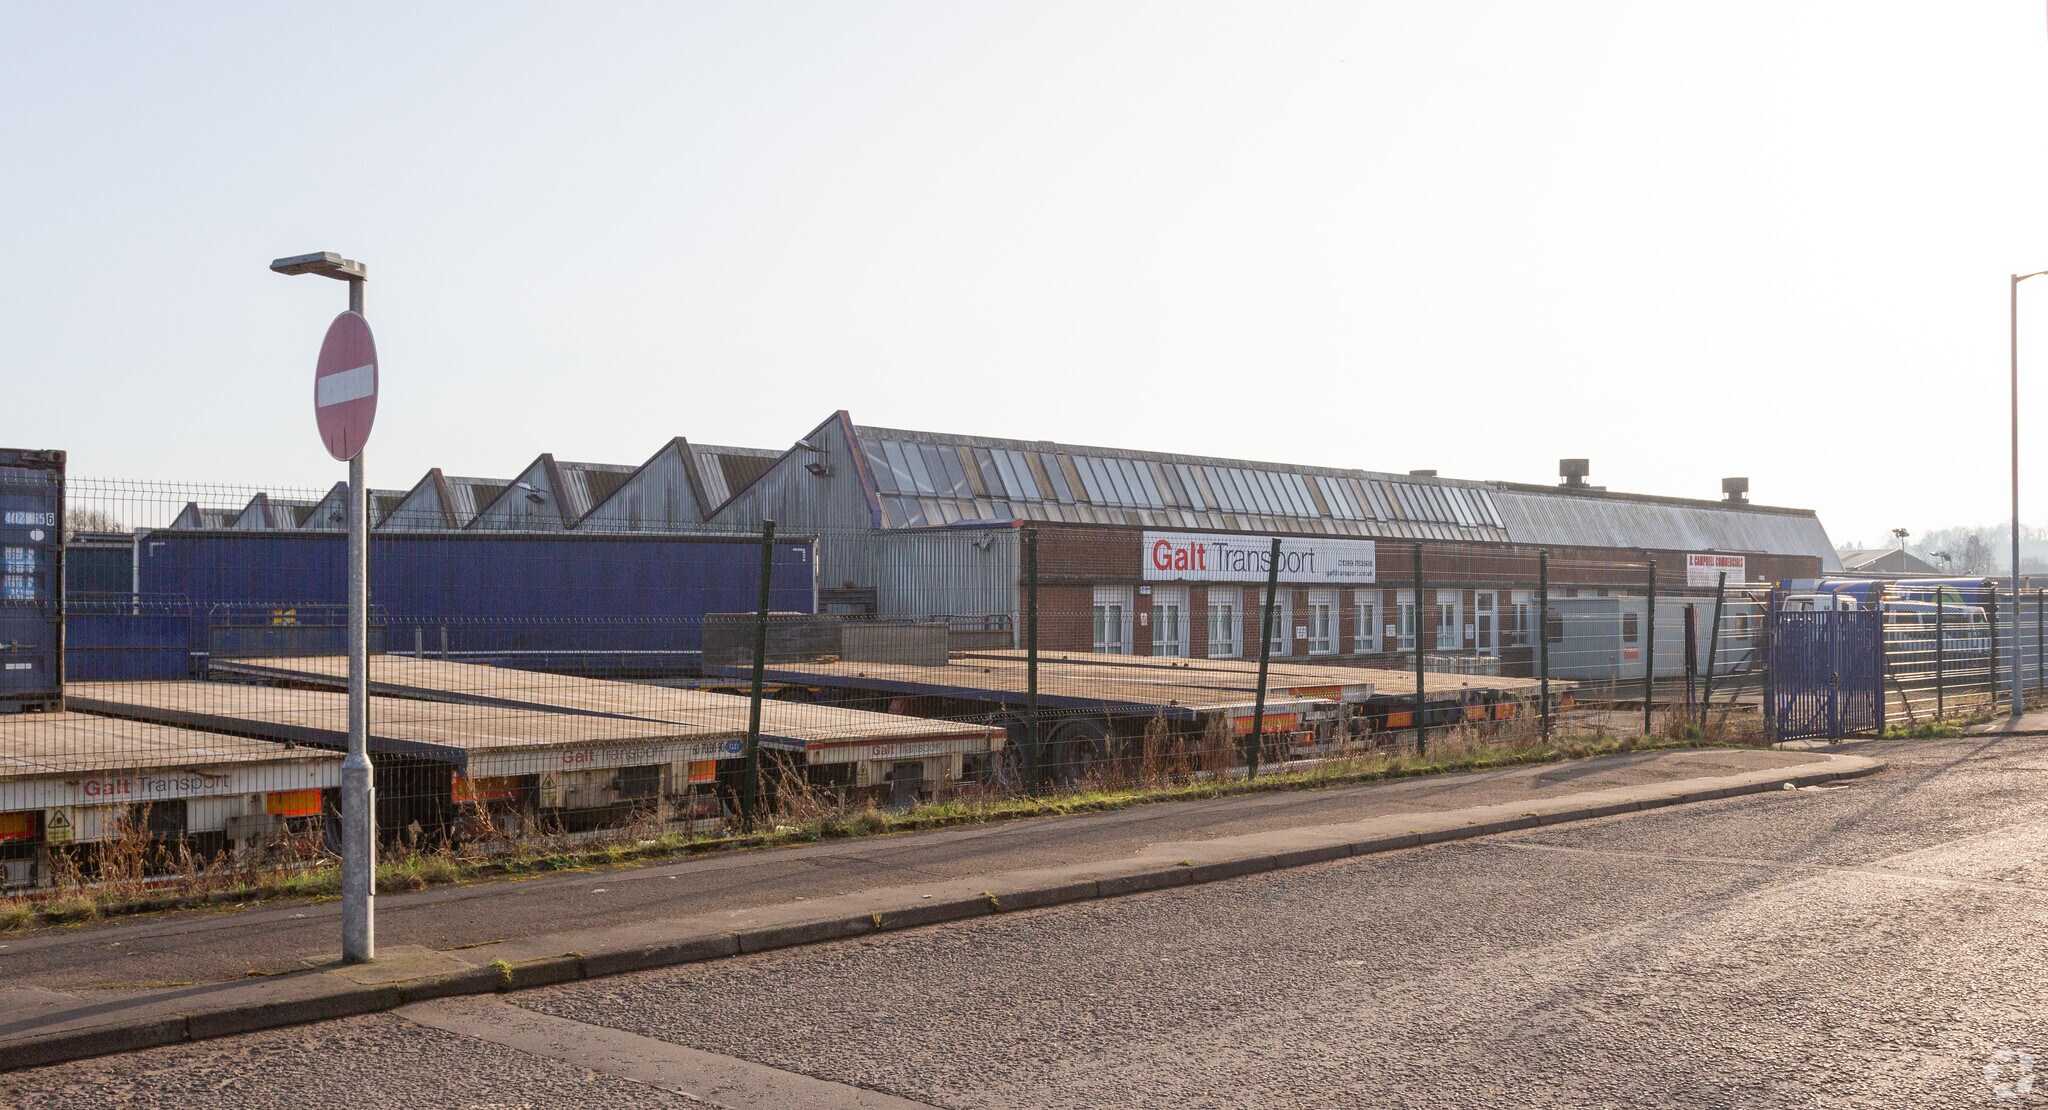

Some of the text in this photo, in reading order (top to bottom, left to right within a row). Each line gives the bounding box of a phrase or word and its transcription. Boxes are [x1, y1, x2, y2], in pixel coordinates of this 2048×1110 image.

[1152, 539, 1206, 571] Galt
[562, 749, 595, 764] Galt
[84, 773, 230, 797] Galt Transport
